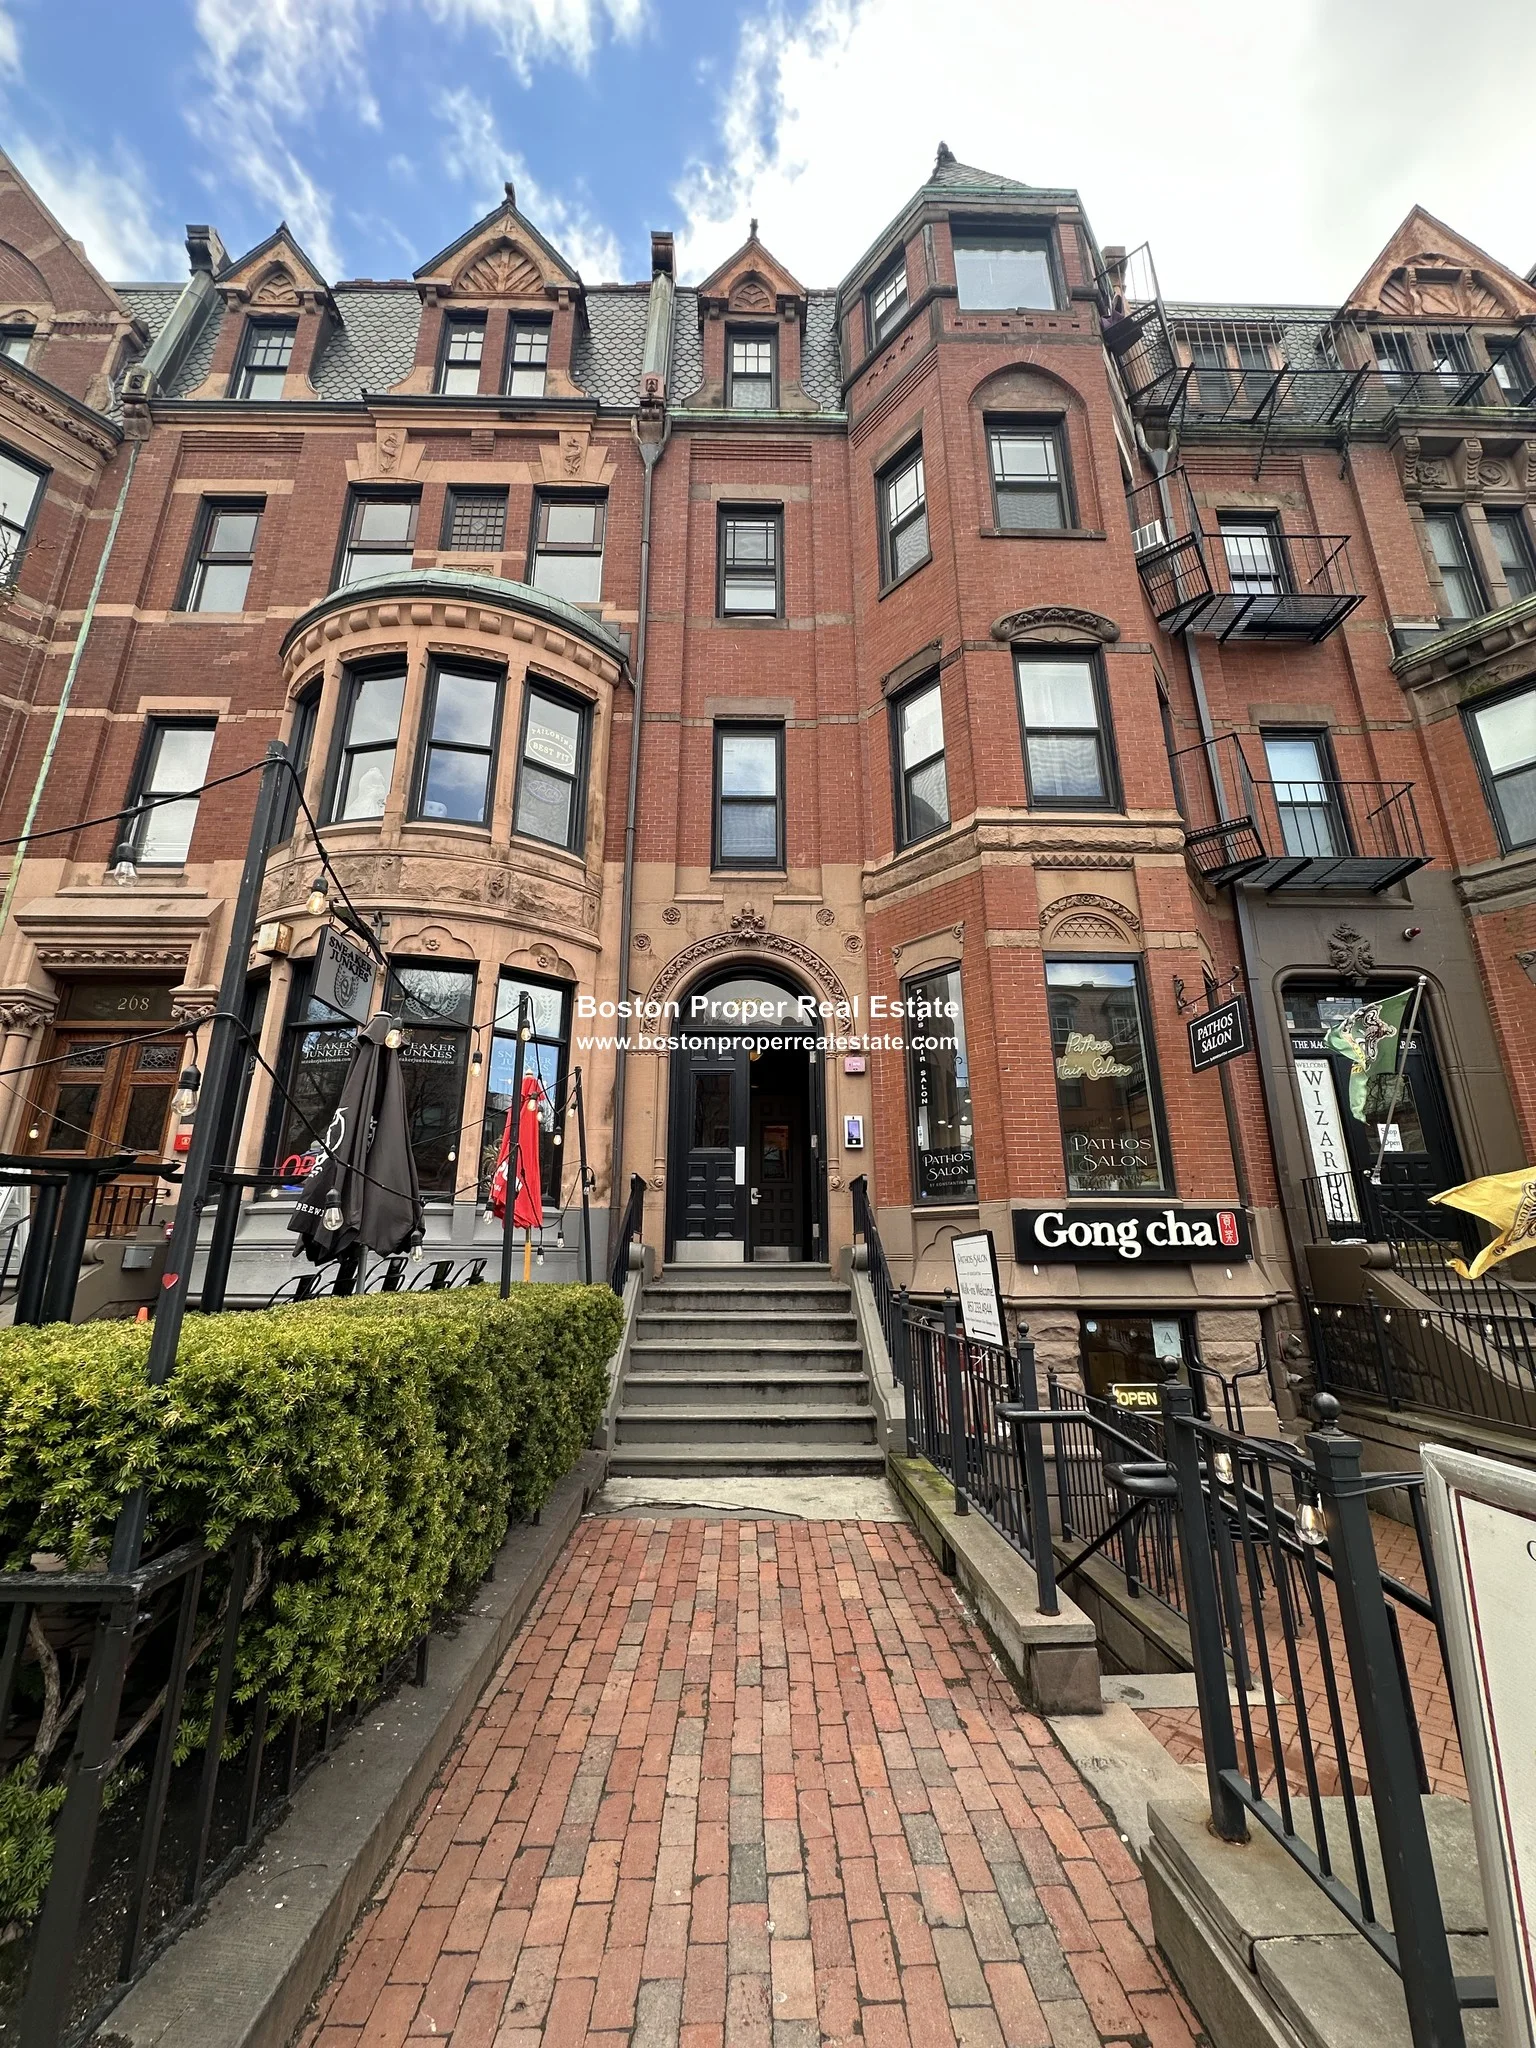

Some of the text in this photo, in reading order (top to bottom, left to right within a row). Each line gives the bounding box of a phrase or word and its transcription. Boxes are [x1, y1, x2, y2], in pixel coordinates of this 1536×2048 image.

[531, 728, 573, 750] TAILORING
[532, 741, 570, 763] BEST FIT
[328, 936, 373, 977] SNEAKER
[329, 948, 370, 983] JUNKIES
[117, 994, 150, 1011] 268
[1197, 1013, 1233, 1041] PATHOS
[411, 1042, 457, 1053] EAKER
[1067, 1034, 1111, 1055] Pathos
[1201, 1029, 1232, 1053] SALON
[1293, 1040, 1309, 1049] THE
[304, 1048, 351, 1059] JUNKIES
[403, 1048, 453, 1059] UNKIES
[1057, 1059, 1085, 1077] Hair
[1089, 1057, 1131, 1077] Salon
[920, 1070, 928, 1104] SALON
[1303, 1070, 1343, 1210] WIZARDS
[1381, 1127, 1398, 1137] Sop
[1071, 1134, 1151, 1151] PATHOS
[923, 1152, 972, 1167] PATHOS
[1079, 1154, 1148, 1172] SALON
[927, 1165, 969, 1181] SALON
[1034, 1210, 1217, 1258] Gong cha
[957, 1253, 988, 1267] PATHOS SALON
[1163, 1331, 1173, 1343] A
[1119, 1391, 1158, 1406] OPEN
